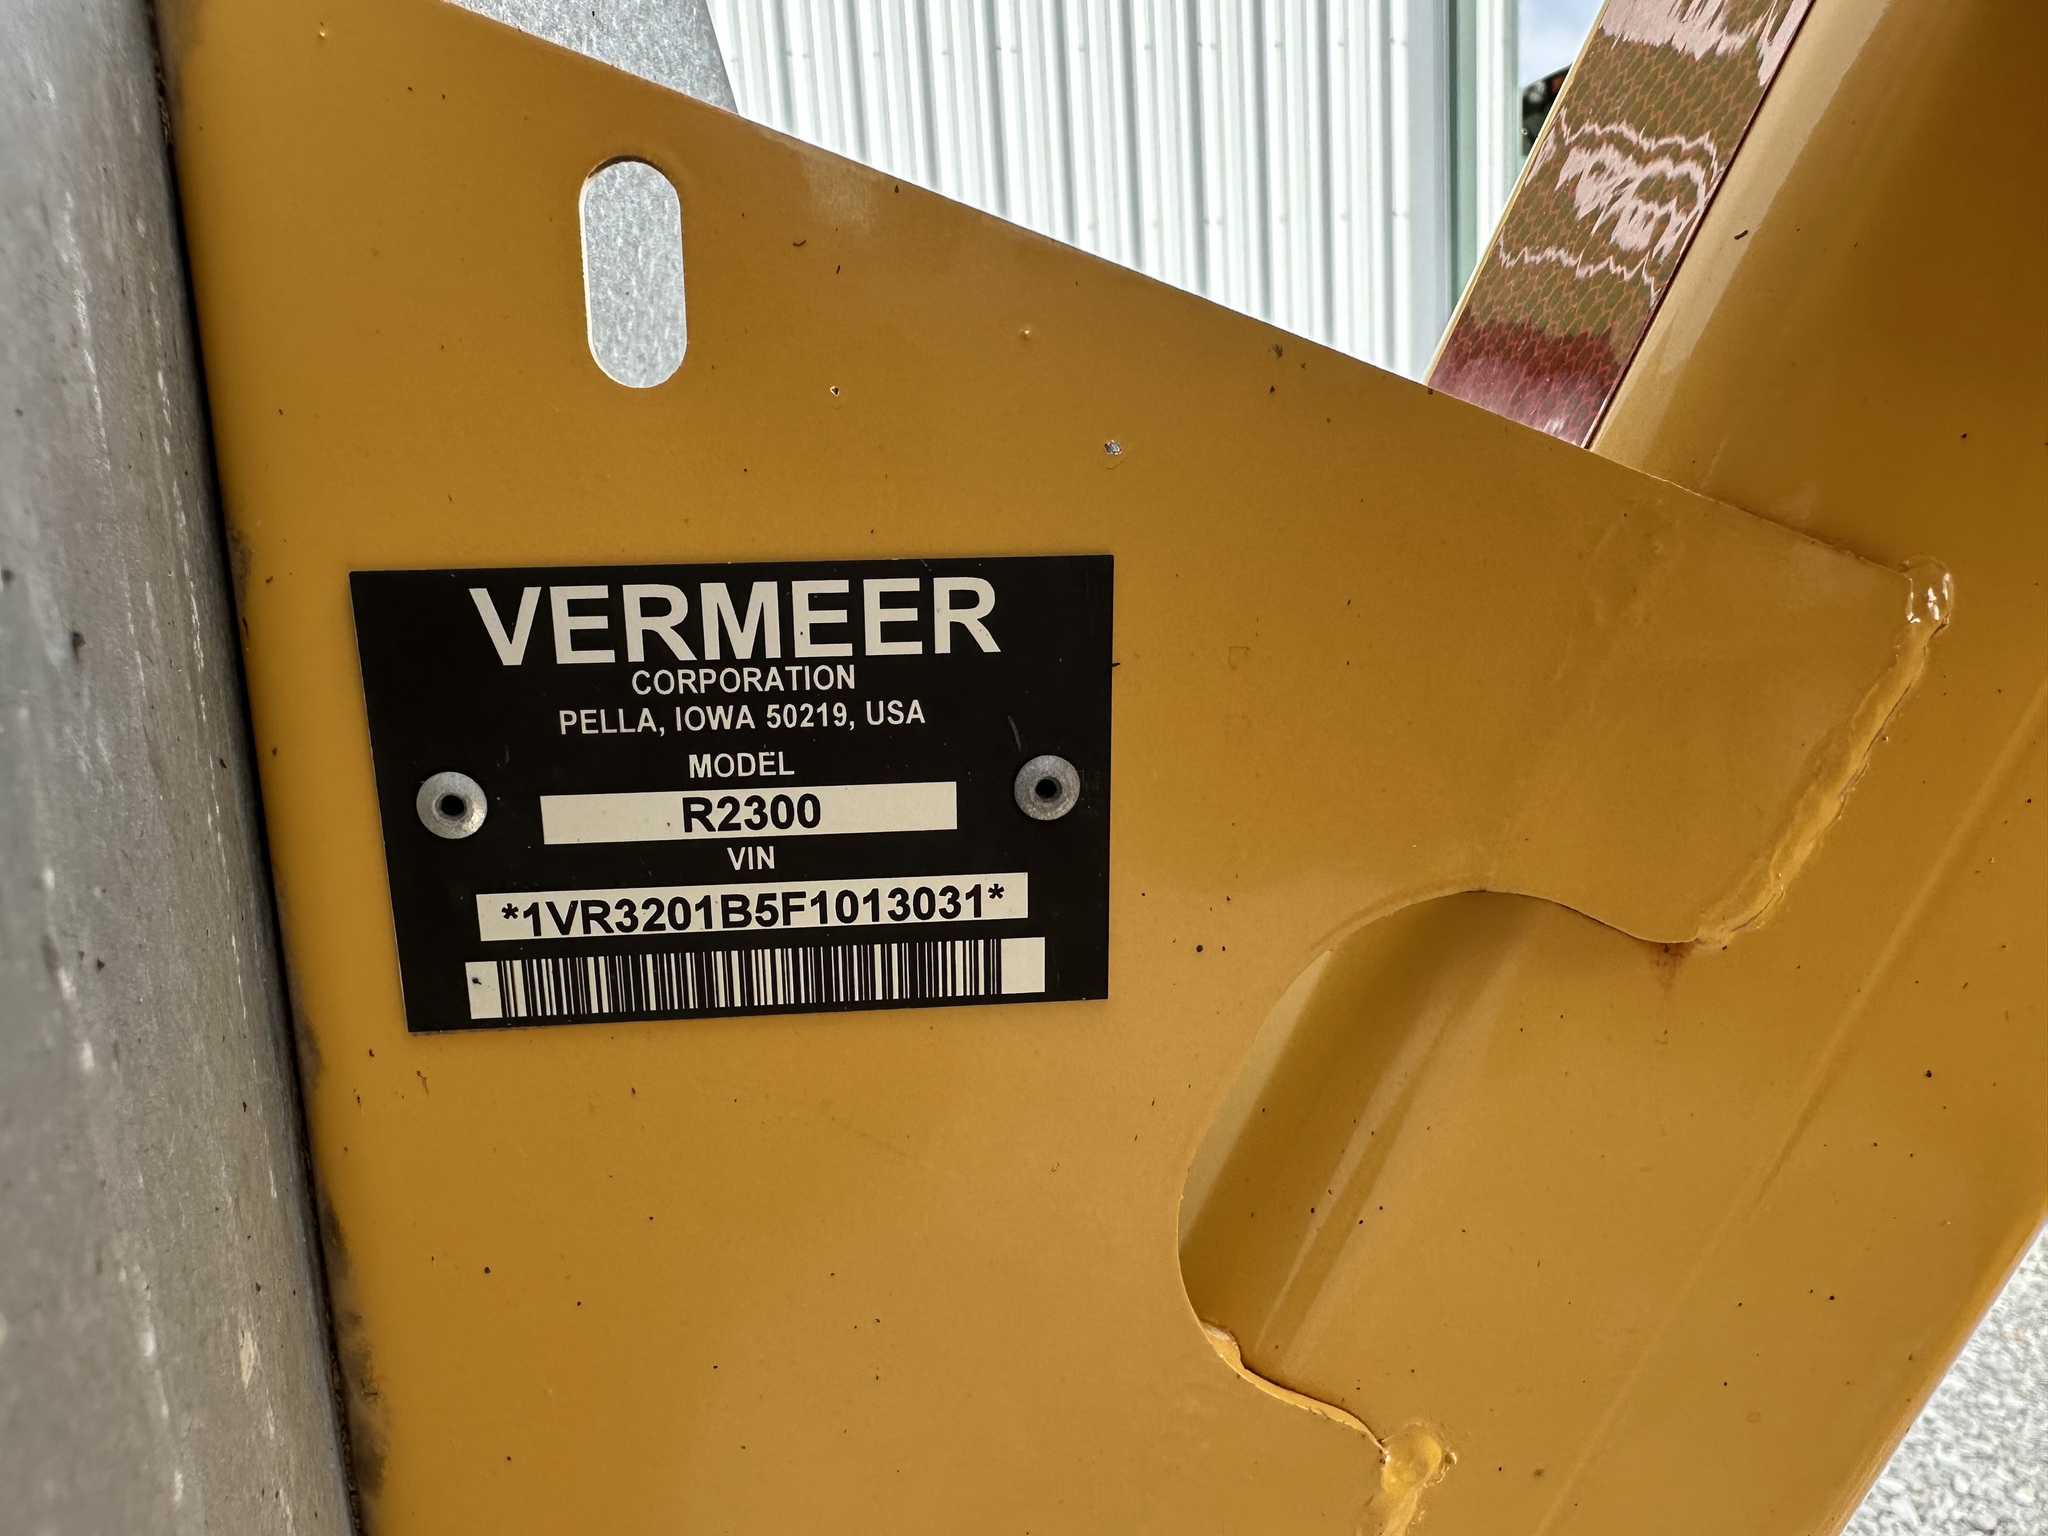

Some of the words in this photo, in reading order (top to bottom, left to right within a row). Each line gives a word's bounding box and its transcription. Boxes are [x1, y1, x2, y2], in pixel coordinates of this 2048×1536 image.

[469, 577, 1001, 665] VERMEER
[631, 664, 855, 695] CORPORATION
[559, 708, 665, 737] PELLA,
[675, 704, 756, 731] IOWA
[766, 702, 855, 731] 50219,
[865, 699, 926, 726] USA
[688, 751, 795, 778] MODEL
[682, 793, 821, 832] R2300
[726, 846, 775, 870] VIN
